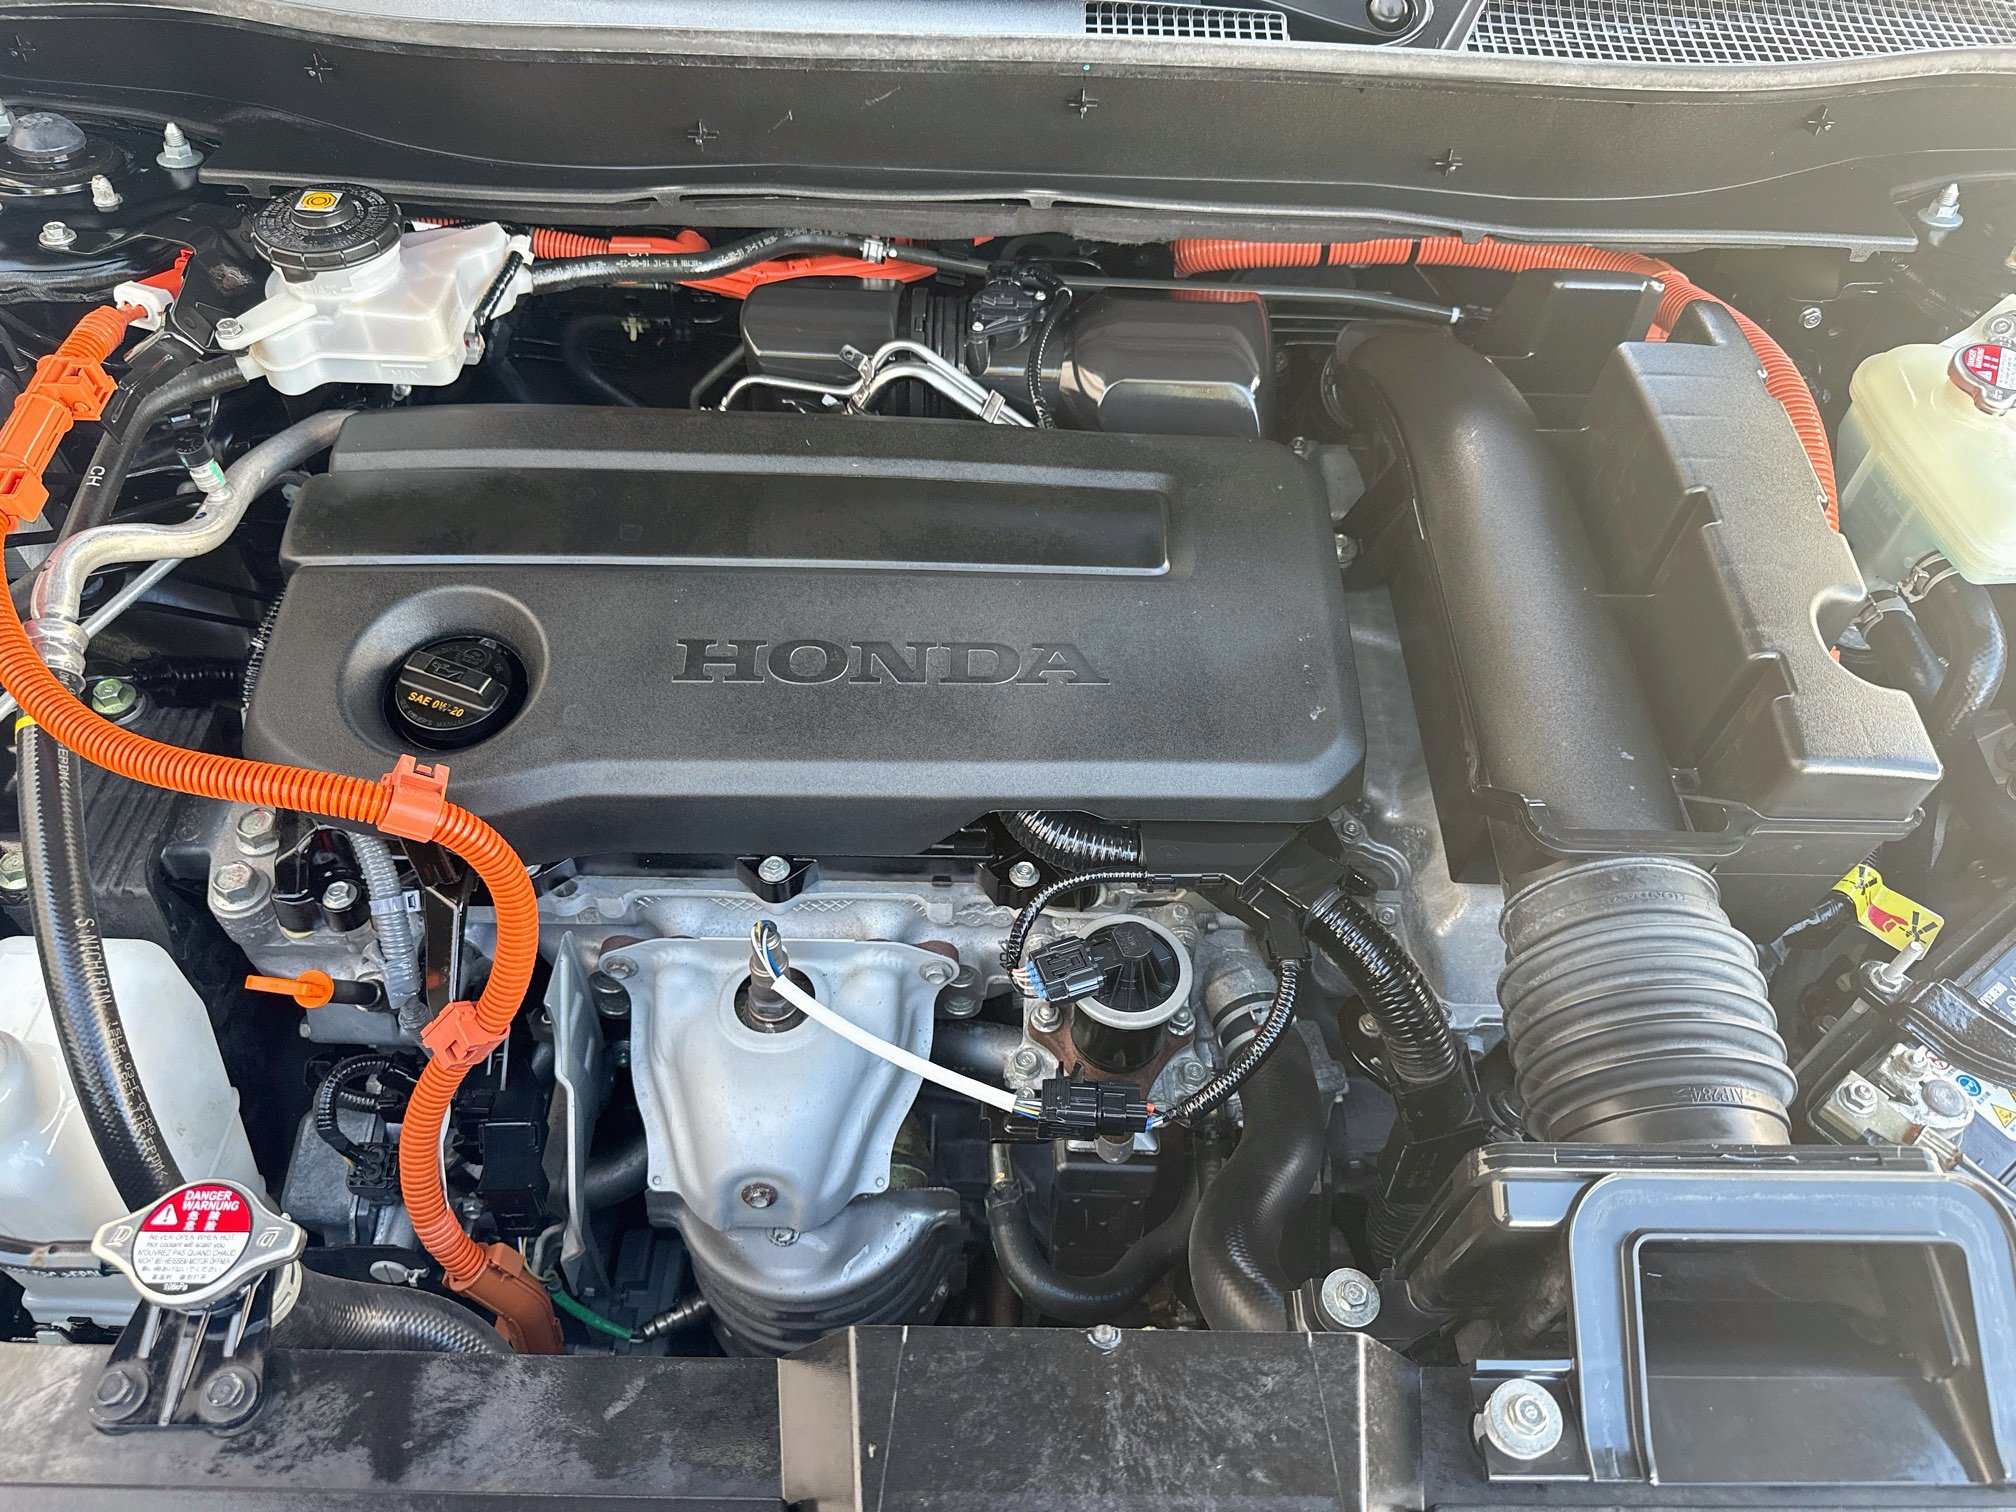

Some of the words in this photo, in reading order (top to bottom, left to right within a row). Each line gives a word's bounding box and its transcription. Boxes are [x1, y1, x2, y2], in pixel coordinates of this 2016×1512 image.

[85, 466, 106, 487] CH
[671, 638, 1111, 686] HONDA
[407, 691, 433, 706] SAE
[431, 699, 465, 718] 0W-20
[184, 1190, 233, 1201] DANGER
[182, 1200, 241, 1211] WARNUNG
[149, 1233, 175, 1241] NEVER
[176, 1233, 195, 1241] OPEN
[196, 1233, 217, 1241] WHEN
[172, 1249, 187, 1257] PAS
[187, 1249, 212, 1257] QUAND
